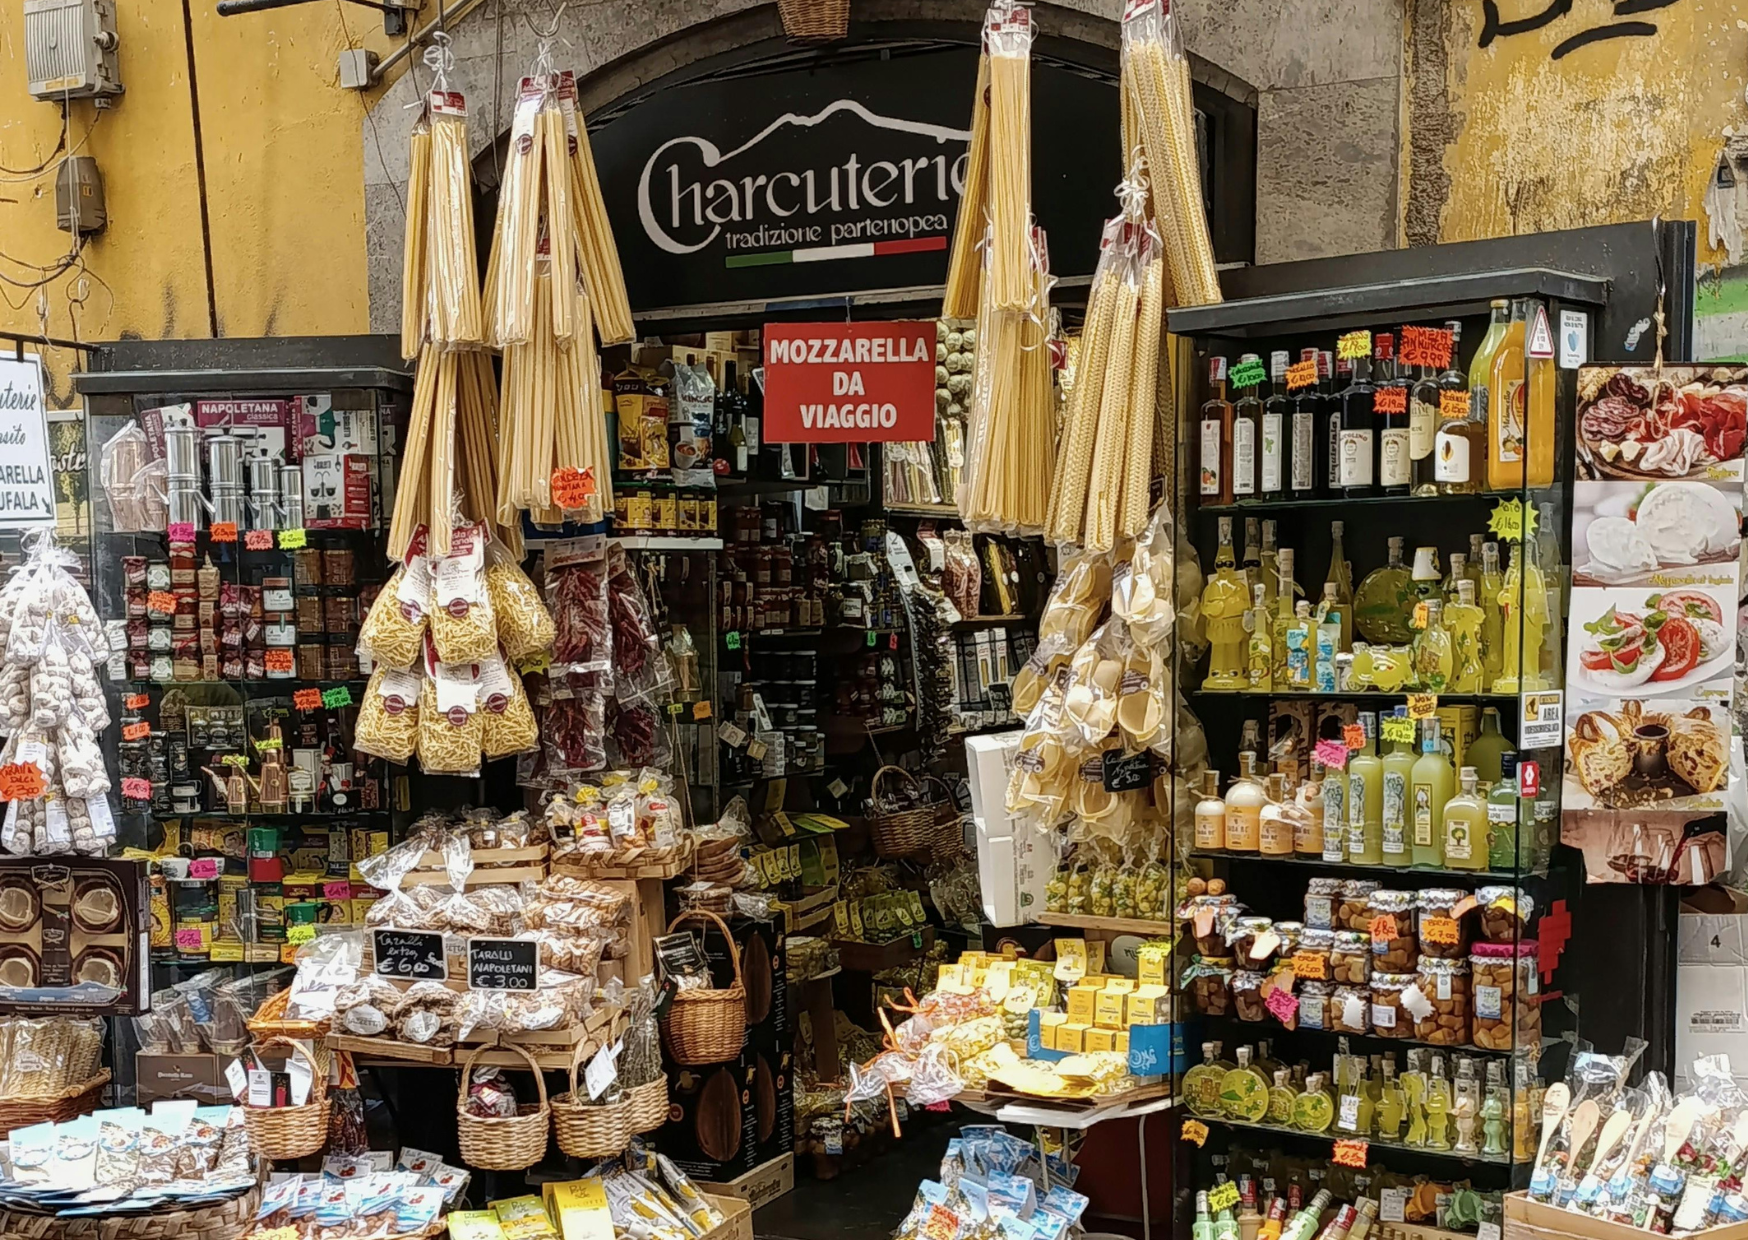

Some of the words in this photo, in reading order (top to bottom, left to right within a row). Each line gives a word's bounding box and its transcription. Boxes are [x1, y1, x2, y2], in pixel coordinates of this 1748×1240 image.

[725, 222, 822, 250] tradizione
[831, 213, 949, 246] partenopea
[769, 337, 930, 365] MOZZARELLA
[832, 371, 866, 397] DA
[201, 402, 279, 415] NAPOLETANA
[247, 412, 279, 421] classica
[799, 403, 898, 429] VIAGGIO
[1710, 934, 1722, 949] 4
[473, 962, 533, 975] NAPOLETANI
